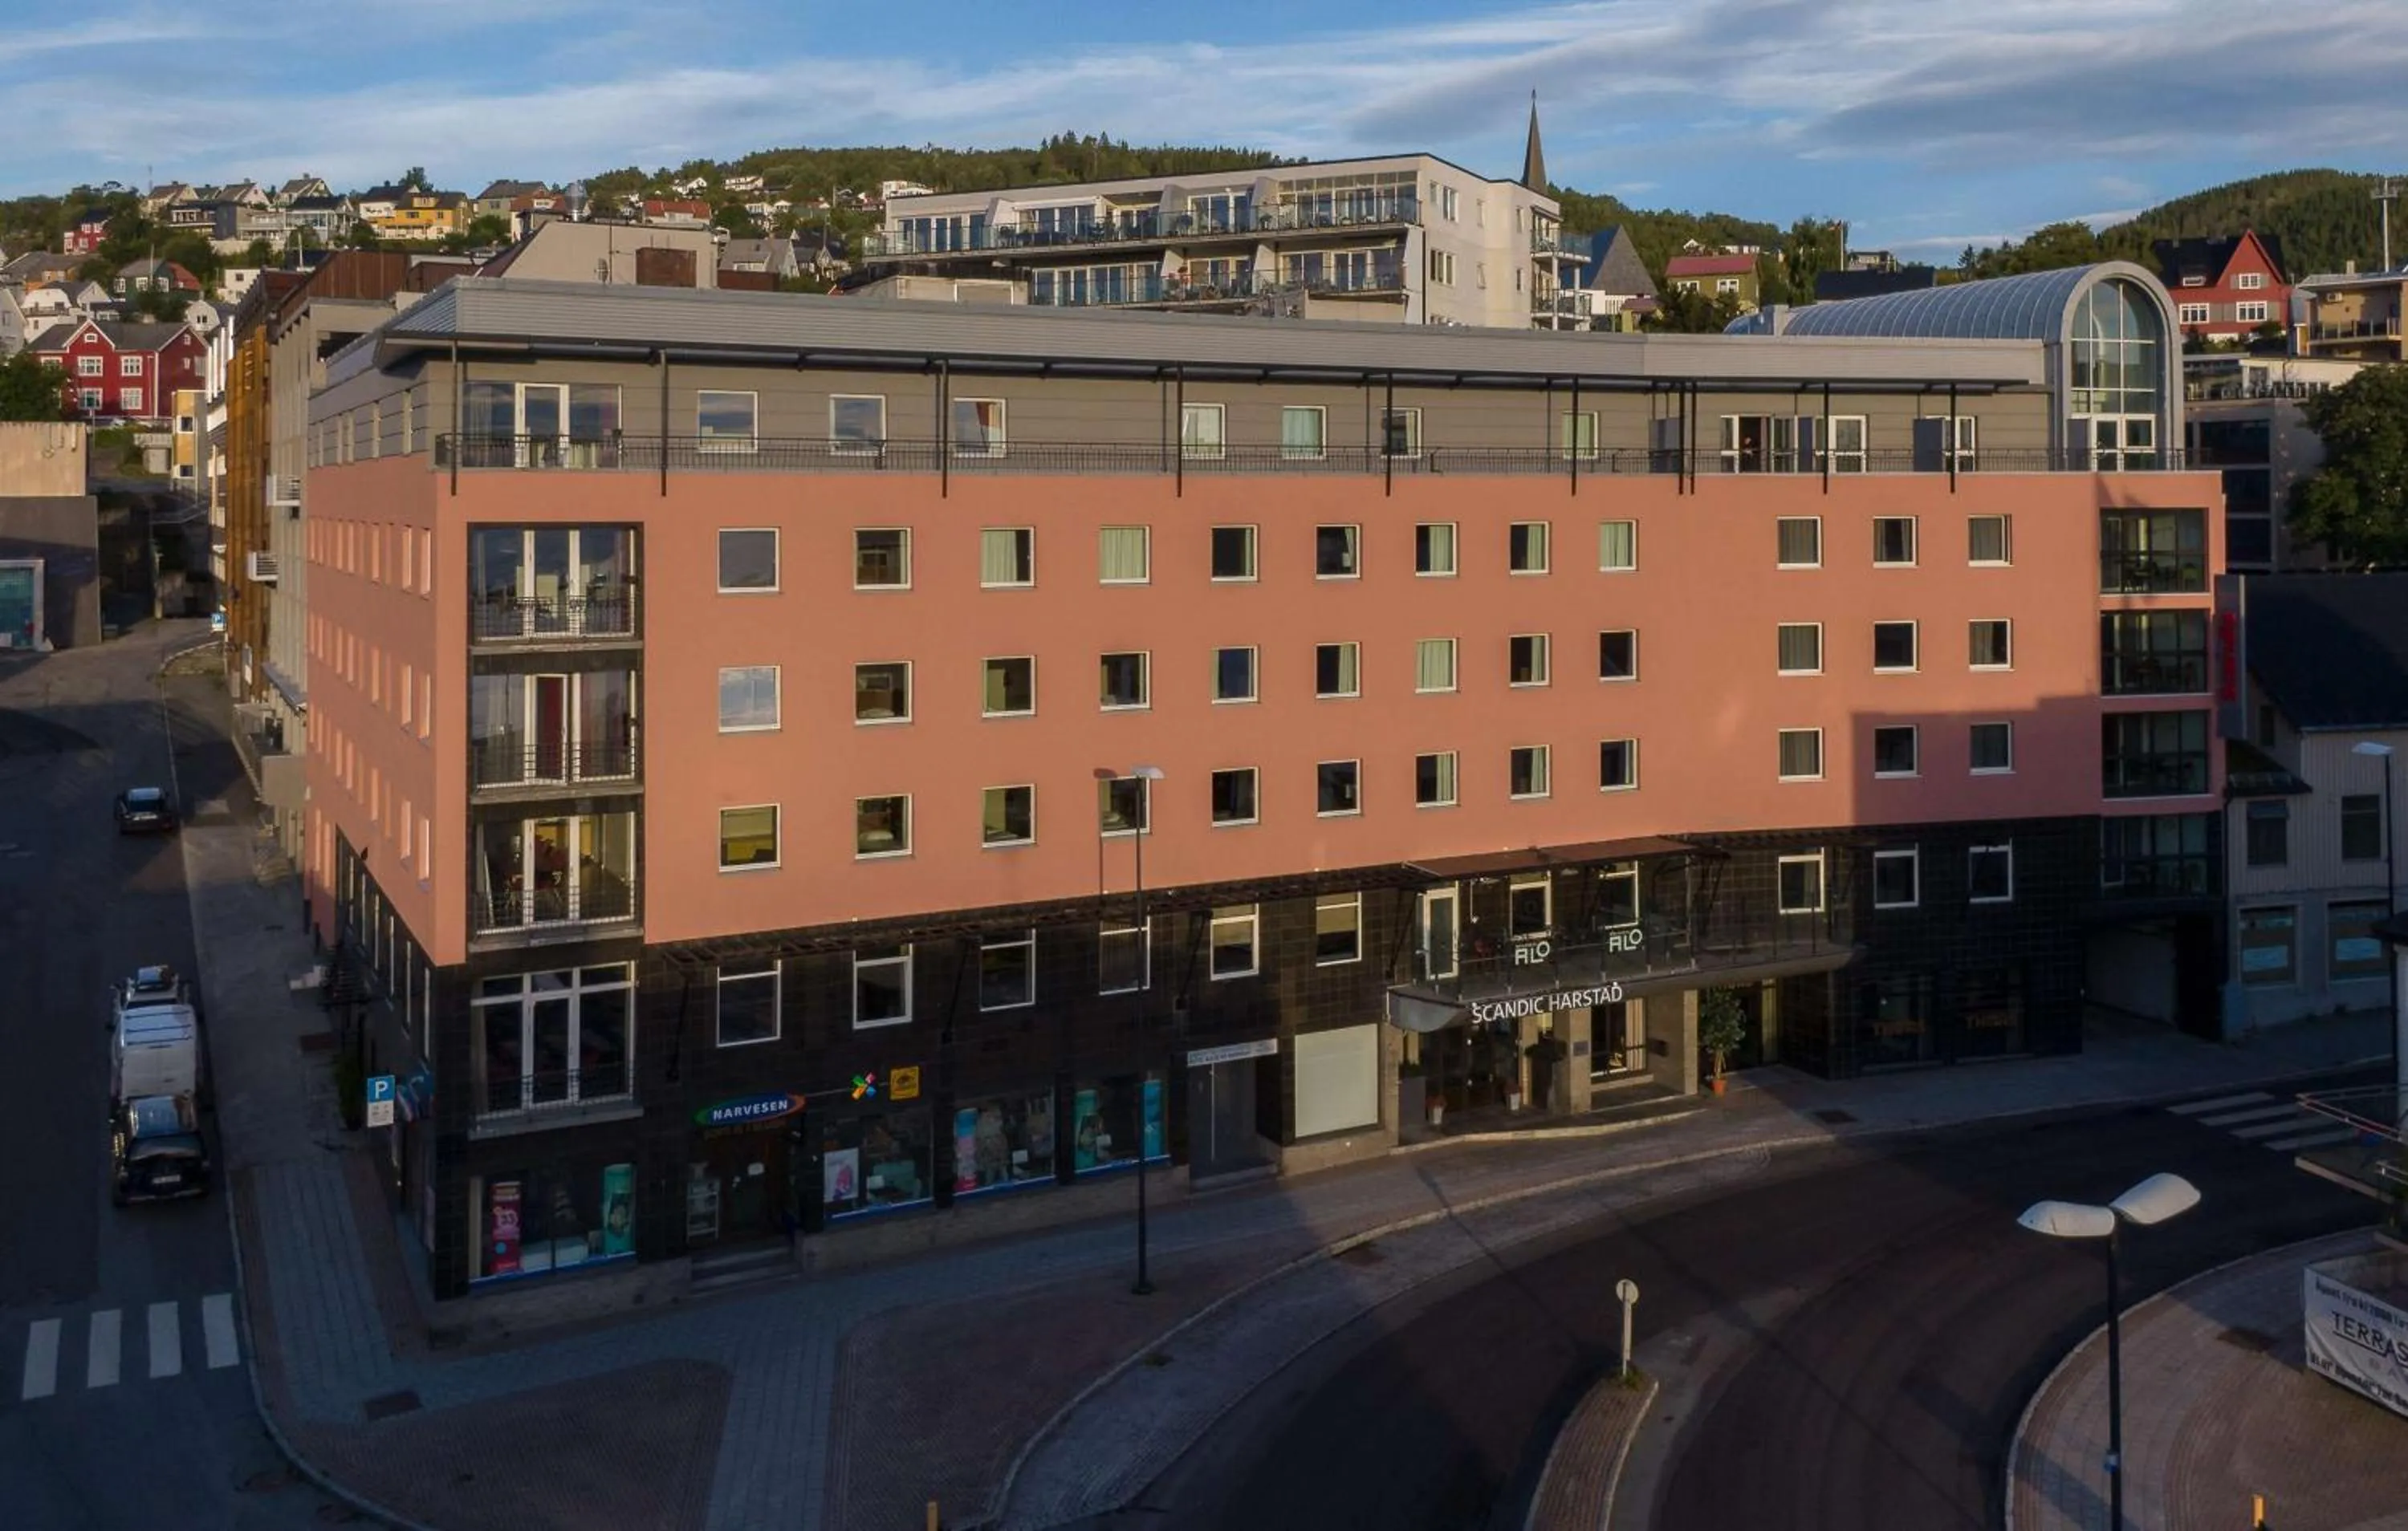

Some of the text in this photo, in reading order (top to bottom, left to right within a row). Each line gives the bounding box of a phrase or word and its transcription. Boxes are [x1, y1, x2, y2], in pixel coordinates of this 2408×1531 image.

[1472, 985, 1622, 1024] SCANDIC HARSTAD
[375, 1081, 388, 1099] P
[713, 1099, 787, 1121] NARVESEN
[2331, 1310, 2408, 1363] TERRAS
